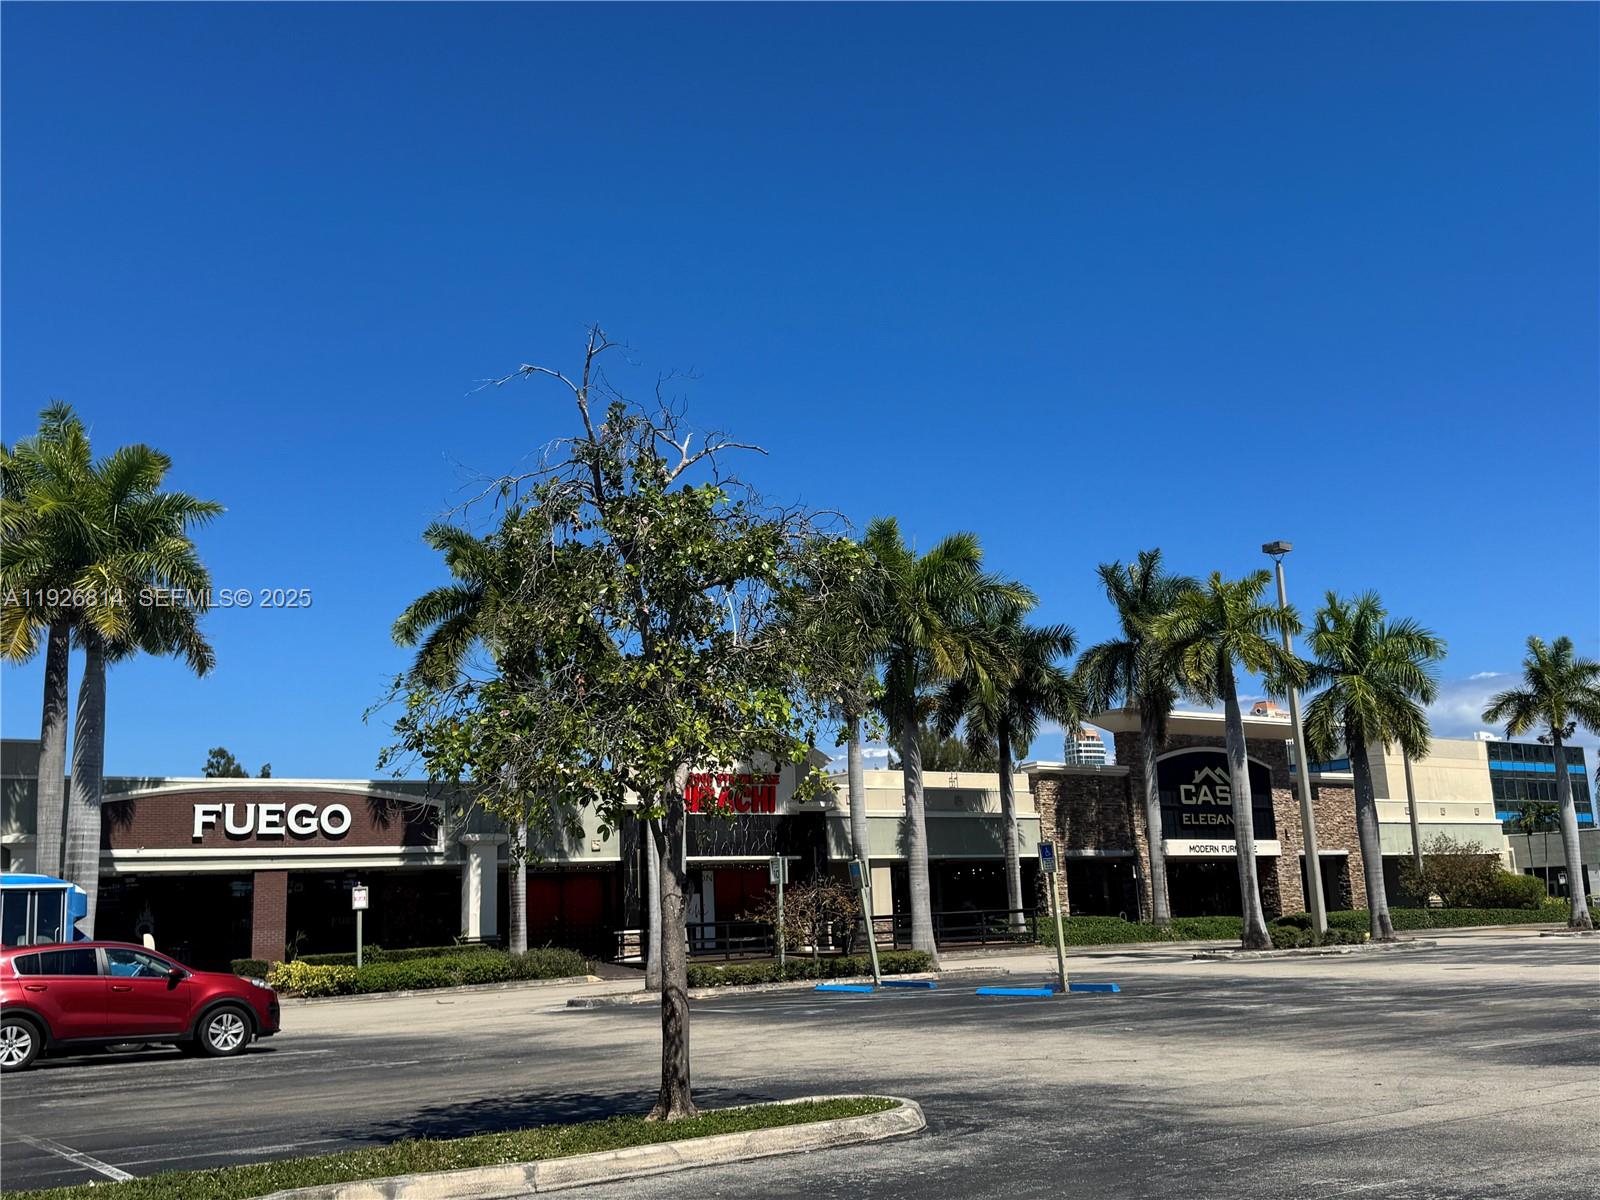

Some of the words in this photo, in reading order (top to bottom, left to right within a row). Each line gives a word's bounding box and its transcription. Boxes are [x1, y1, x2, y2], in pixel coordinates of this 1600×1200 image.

[1180, 784, 1232, 805] CAS
[192, 803, 352, 838] FUEGO
[1189, 844, 1219, 853] MODERN
